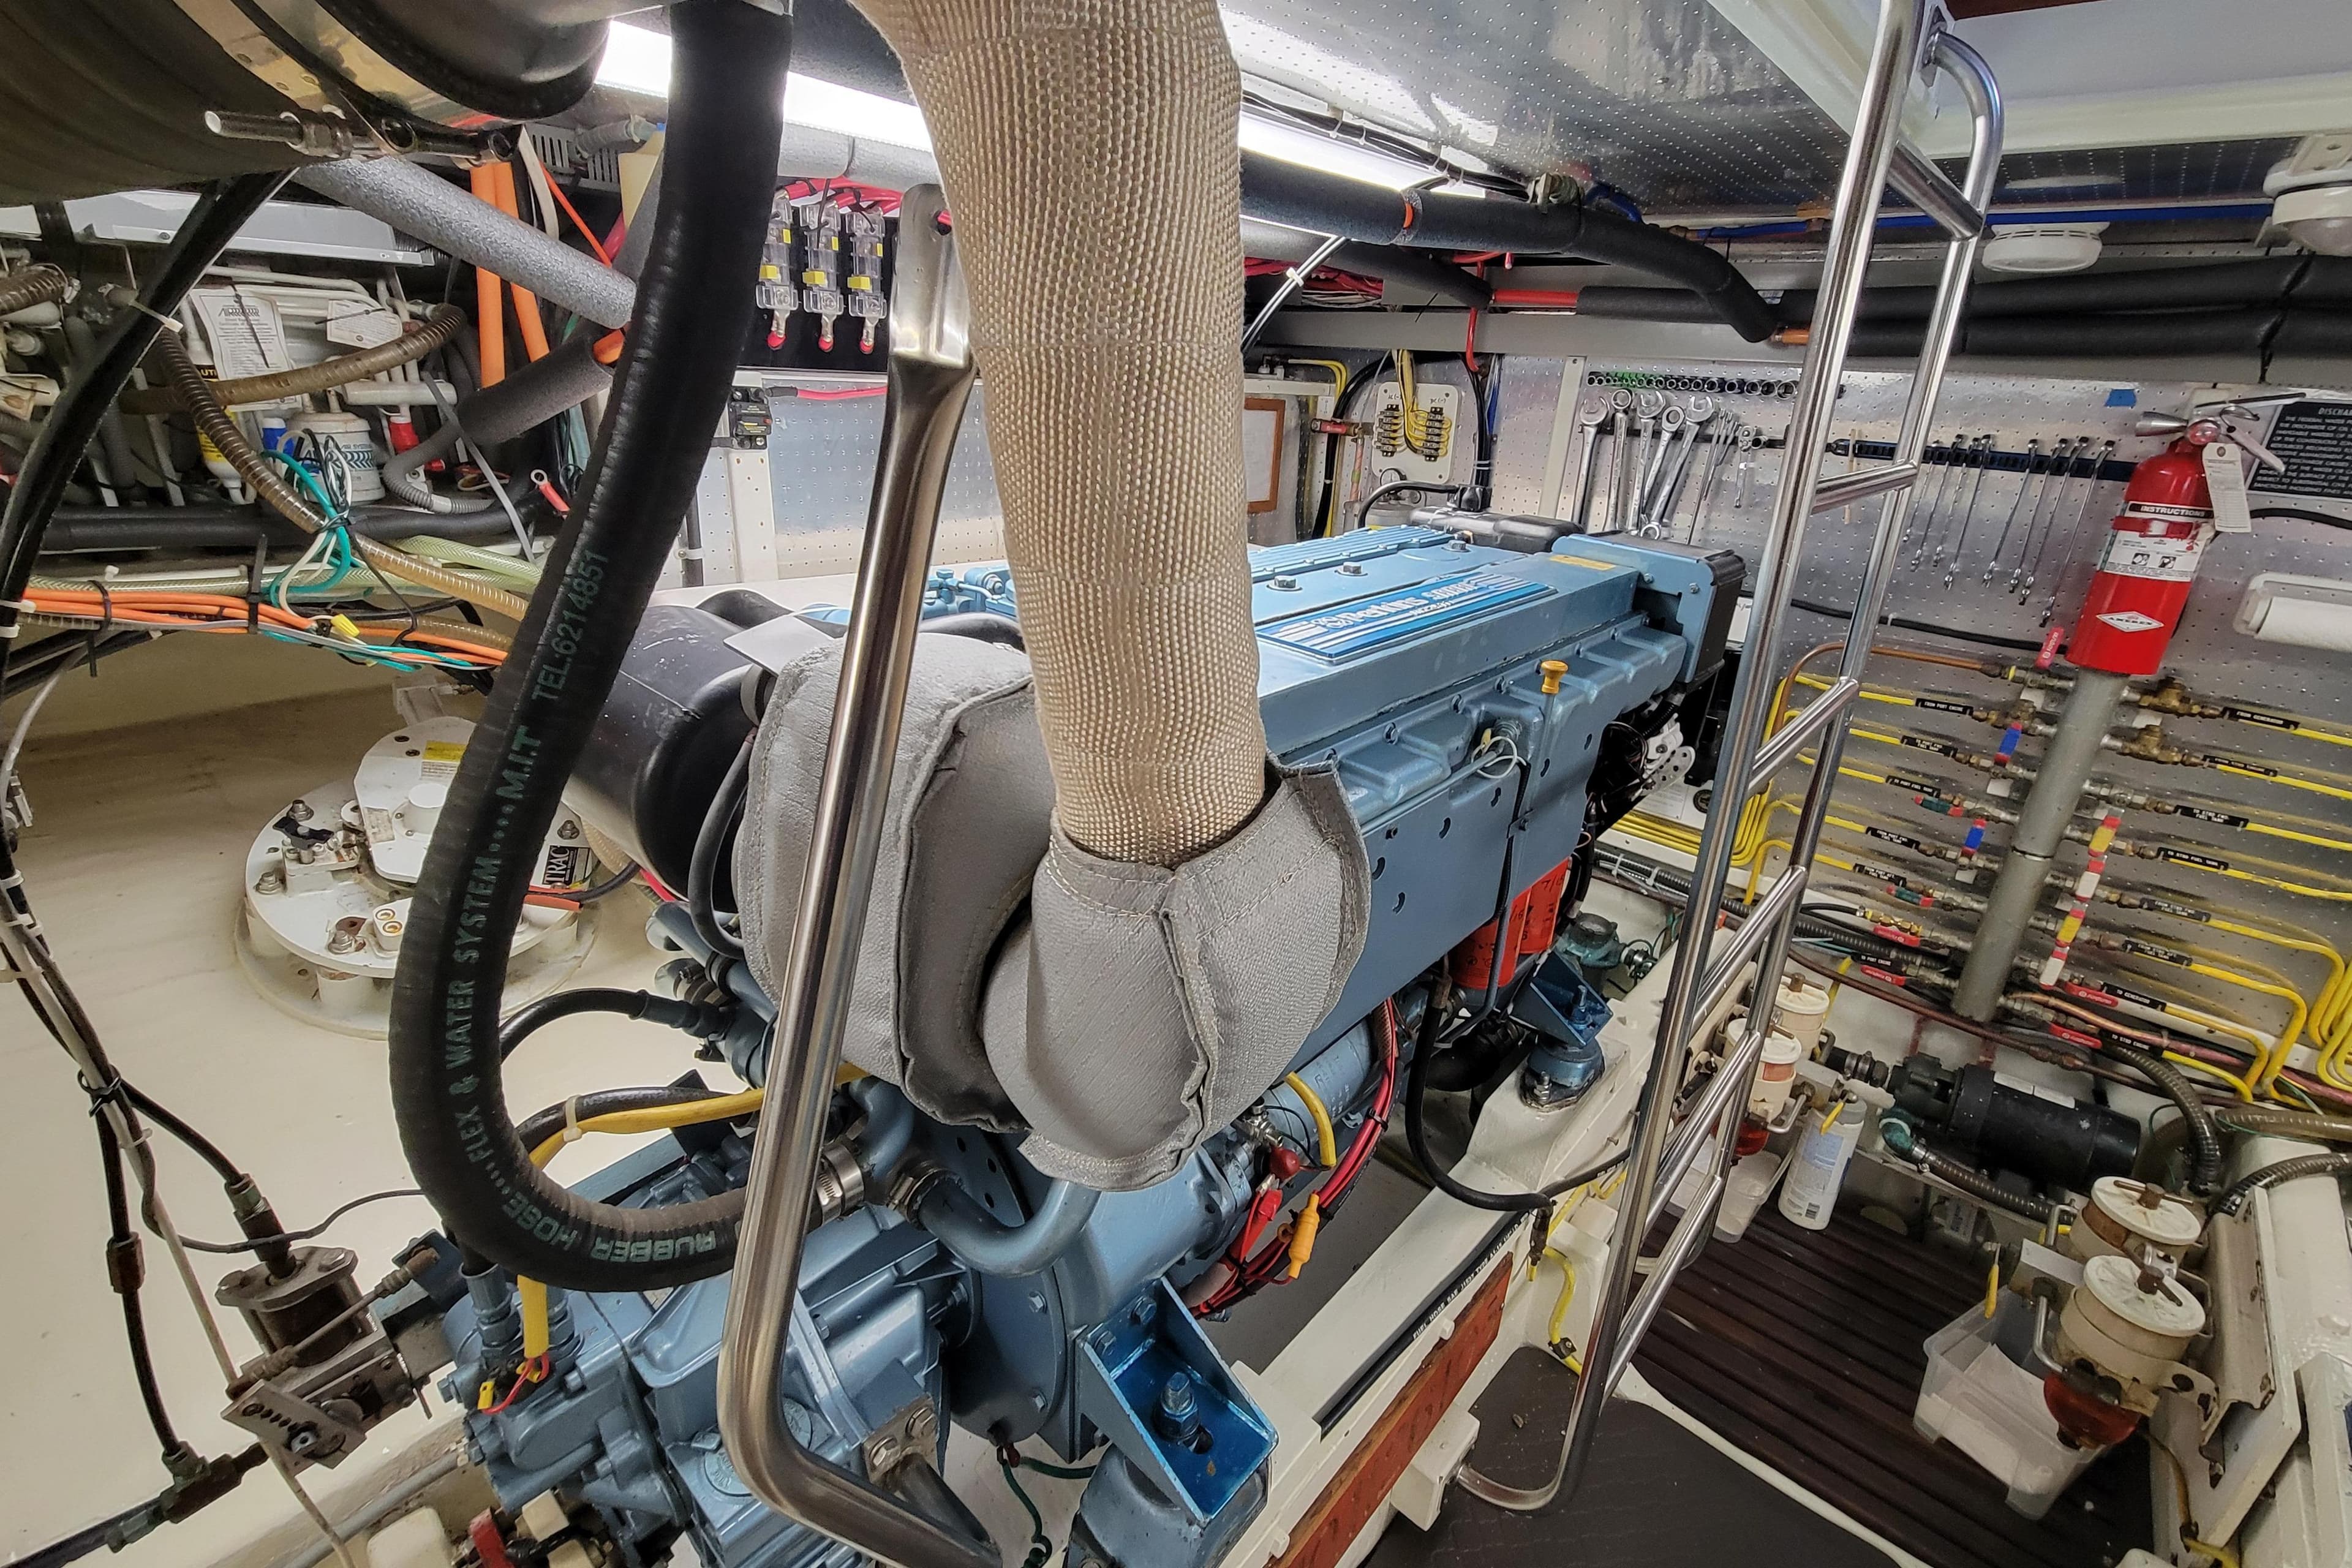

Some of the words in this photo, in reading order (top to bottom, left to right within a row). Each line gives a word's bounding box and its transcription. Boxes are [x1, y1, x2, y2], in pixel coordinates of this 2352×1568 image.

[2141, 505, 2205, 517] INSTRUCTIONS
[543, 846, 570, 884] TRAC
[451, 856, 501, 964] SYSTEM
[445, 980, 476, 1069] WATER
[454, 1105, 494, 1163] FLEX
[502, 1191, 578, 1251] HOSE
[590, 1230, 716, 1262] RUBBER
